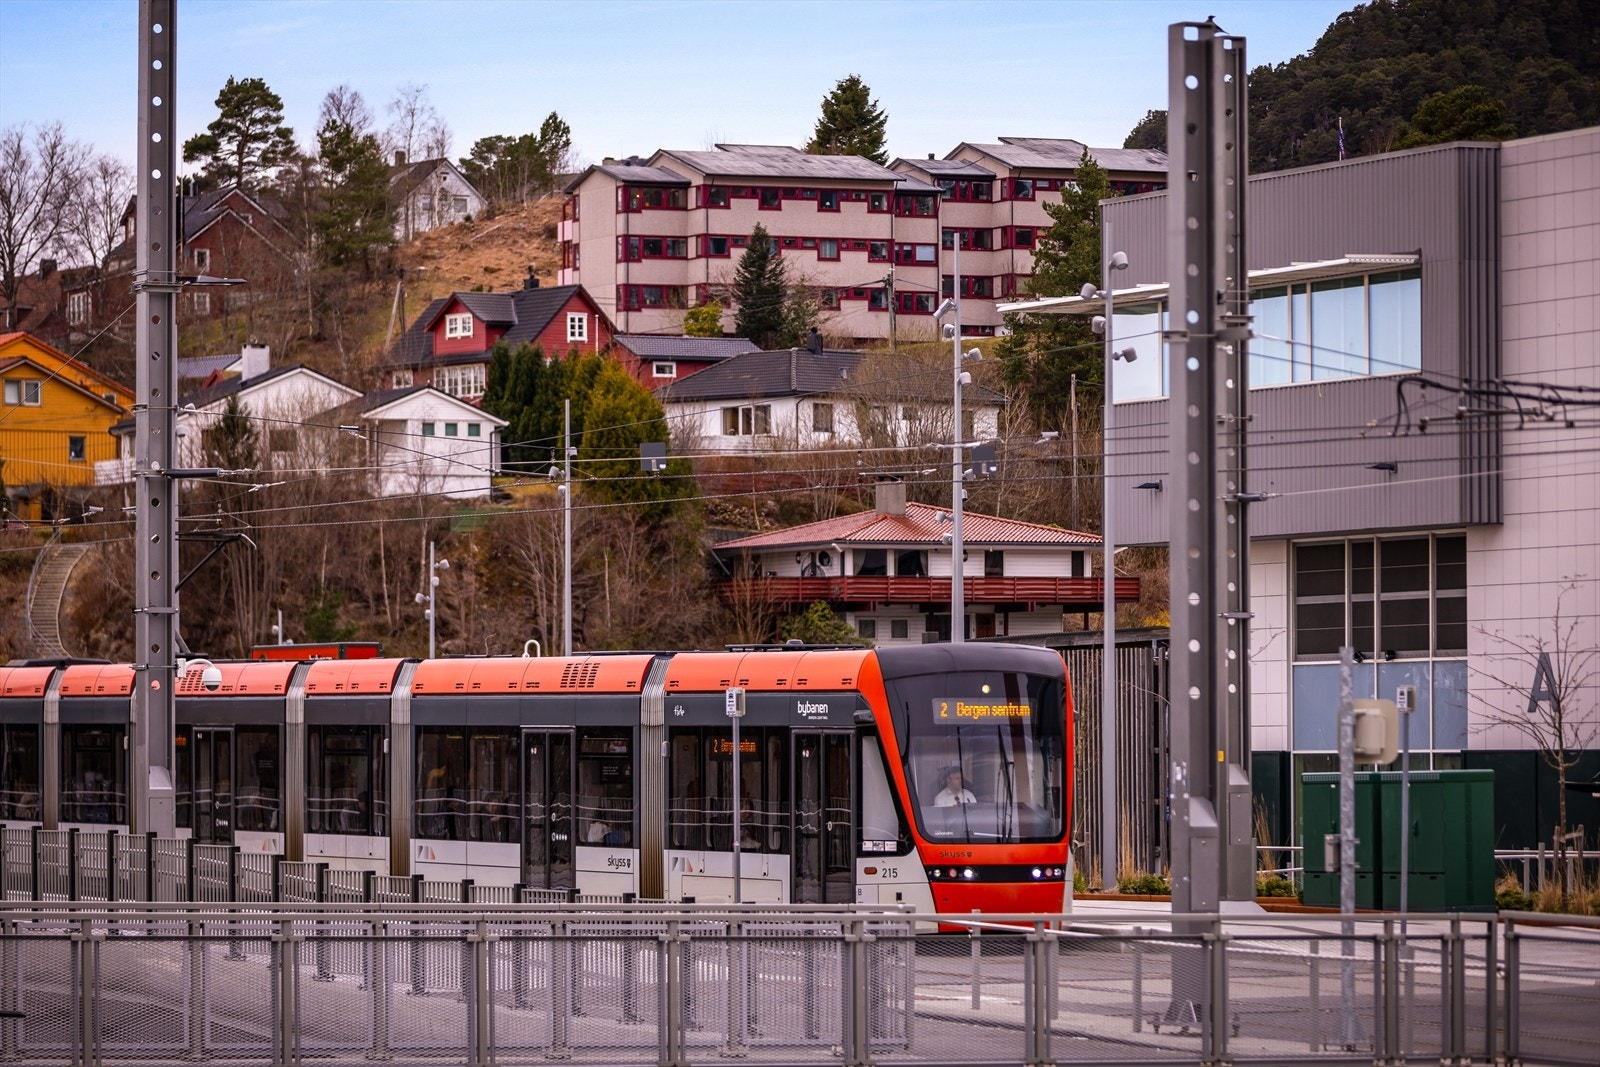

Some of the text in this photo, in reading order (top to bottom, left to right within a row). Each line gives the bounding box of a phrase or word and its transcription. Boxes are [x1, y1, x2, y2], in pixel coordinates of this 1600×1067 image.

[1527, 652, 1561, 713] A
[797, 700, 829, 717] bybanen
[940, 701, 1031, 720] 2 Bergen sentrum
[940, 850, 966, 858] skyss
[607, 855, 627, 869] skyss
[882, 868, 898, 879] 215
